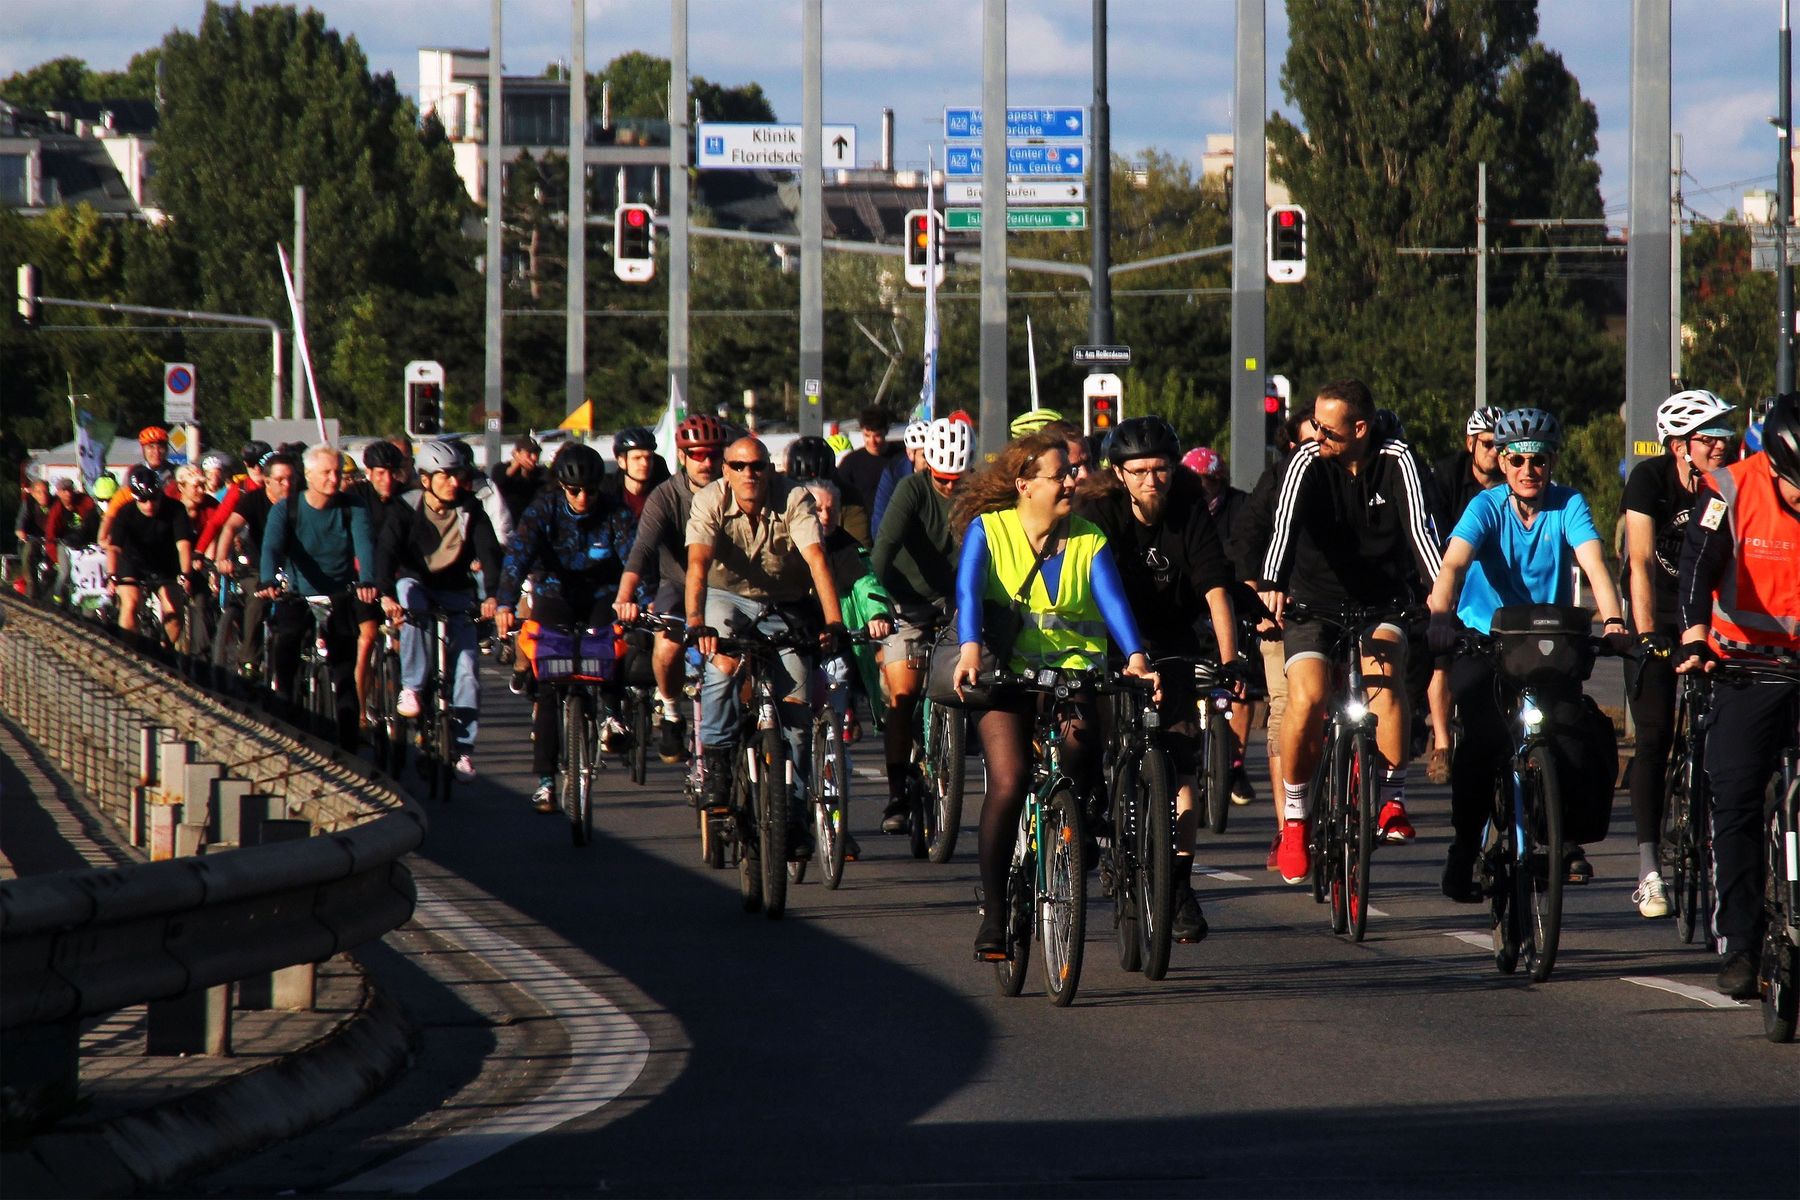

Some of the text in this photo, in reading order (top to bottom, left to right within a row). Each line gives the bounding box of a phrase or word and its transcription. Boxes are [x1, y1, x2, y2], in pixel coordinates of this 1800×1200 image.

[951, 117, 967, 129] A22
[752, 128, 796, 143] Klinik
[732, 149, 802, 164] Floridsdo
[1010, 148, 1041, 159] Center
[951, 155, 967, 167] A22
[1009, 161, 1062, 172] Int. Centre
[1744, 537, 1795, 551] POLIZEI
